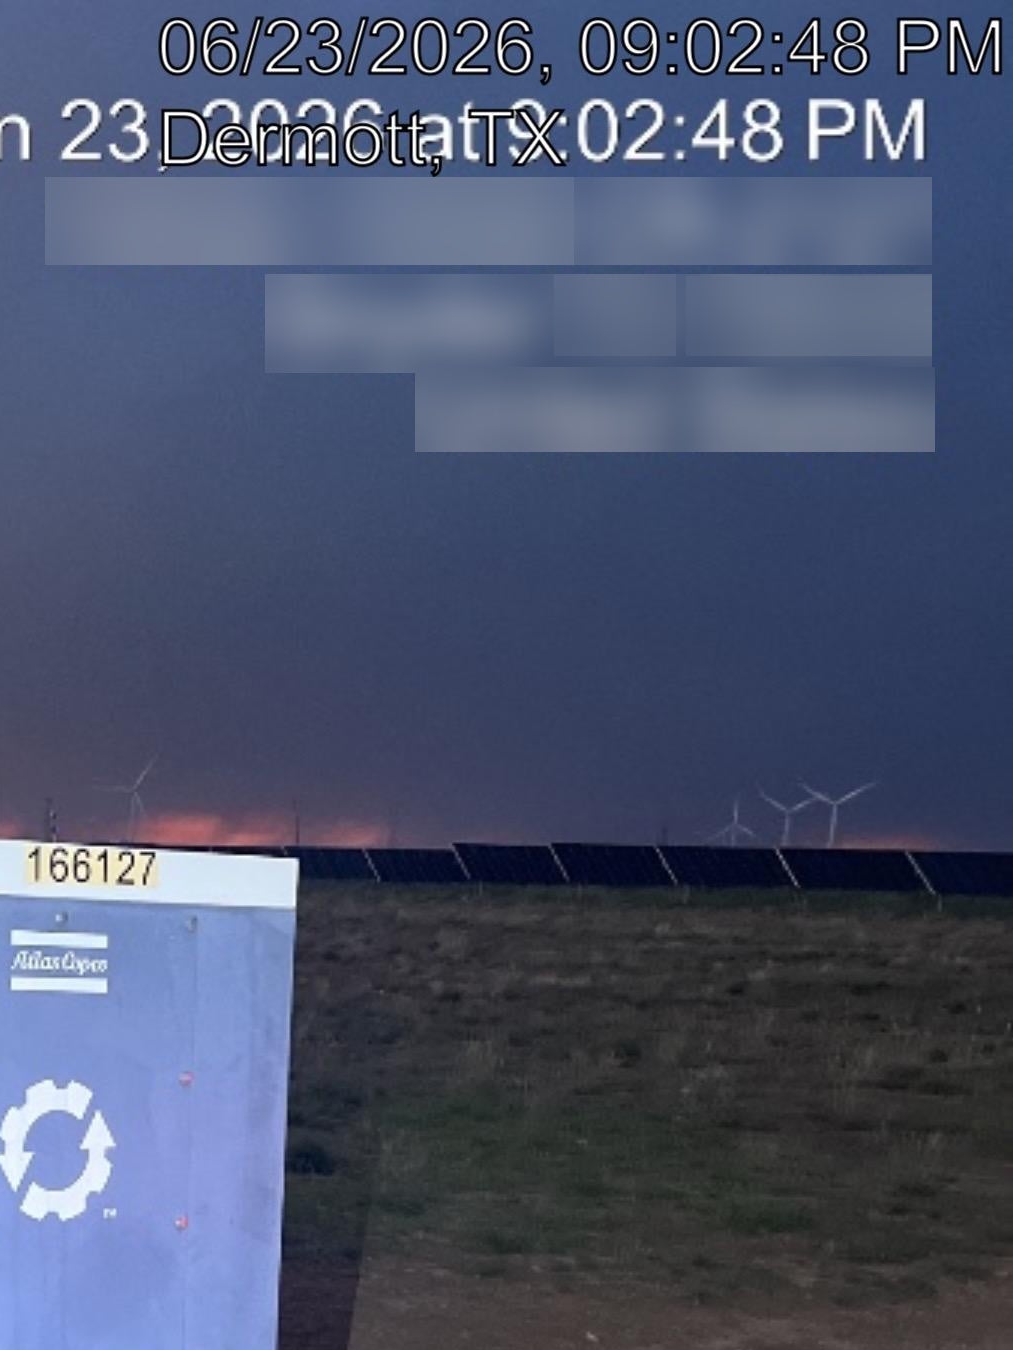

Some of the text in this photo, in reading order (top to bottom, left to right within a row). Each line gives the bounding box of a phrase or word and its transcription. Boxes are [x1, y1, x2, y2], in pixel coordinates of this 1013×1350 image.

[28, 846, 157, 886] 166127
[11, 950, 108, 975] Atlas Copco
